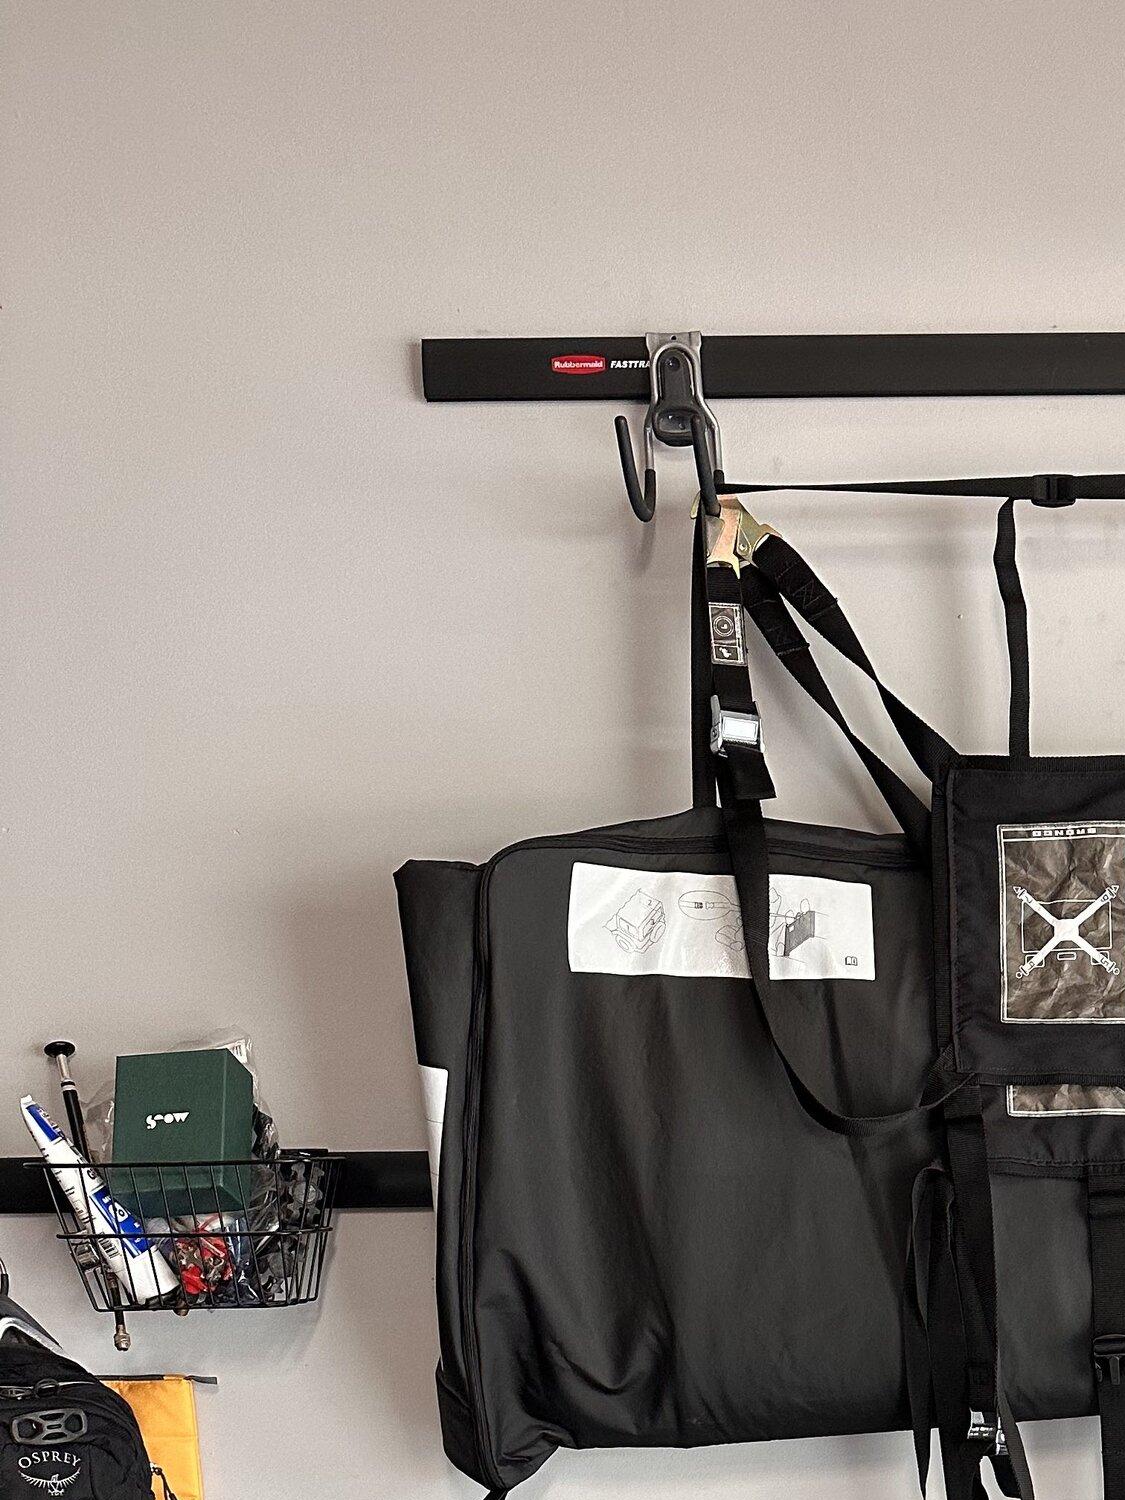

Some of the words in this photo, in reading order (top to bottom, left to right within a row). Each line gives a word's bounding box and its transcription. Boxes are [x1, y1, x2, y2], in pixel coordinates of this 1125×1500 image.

[553, 360, 603, 369] Rubbermaid
[610, 360, 651, 369] FASTTRA
[18, 1450, 81, 1469] OSPREY
